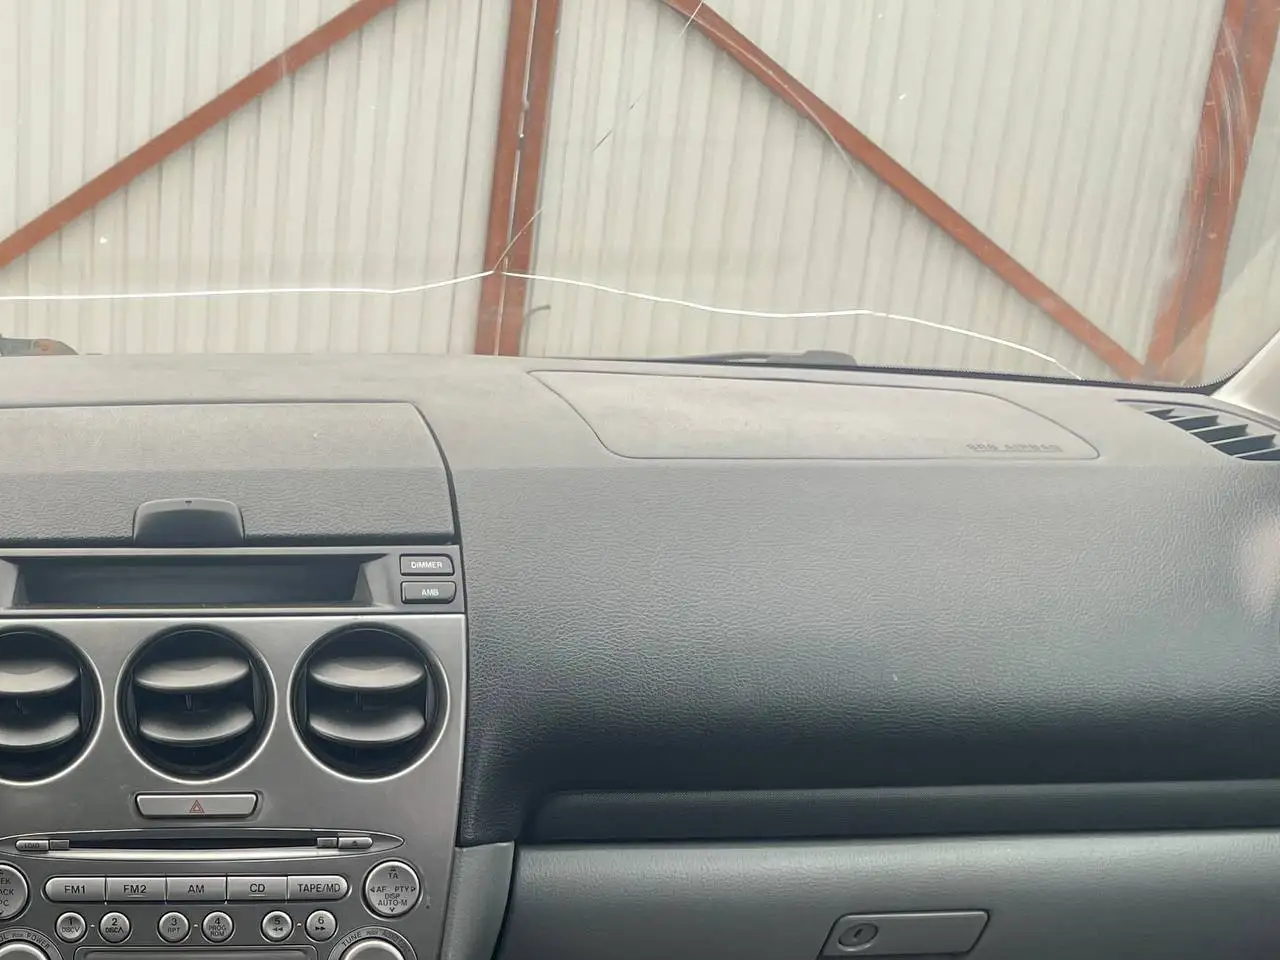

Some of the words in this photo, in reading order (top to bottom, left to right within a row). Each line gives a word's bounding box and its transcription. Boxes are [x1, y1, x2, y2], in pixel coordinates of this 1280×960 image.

[411, 561, 443, 569] DIMMER
[421, 589, 439, 597] AMB
[64, 885, 86, 894] FM1
[123, 884, 147, 894] FM2
[187, 885, 205, 894] AM
[249, 883, 266, 893] CD
[297, 883, 341, 893] TAPE/MD
[112, 918, 118, 926] 2
[171, 918, 178, 926] 3
[274, 917, 281, 926] 5
[318, 916, 324, 925] 6
[341, 932, 362, 946] TUNE
